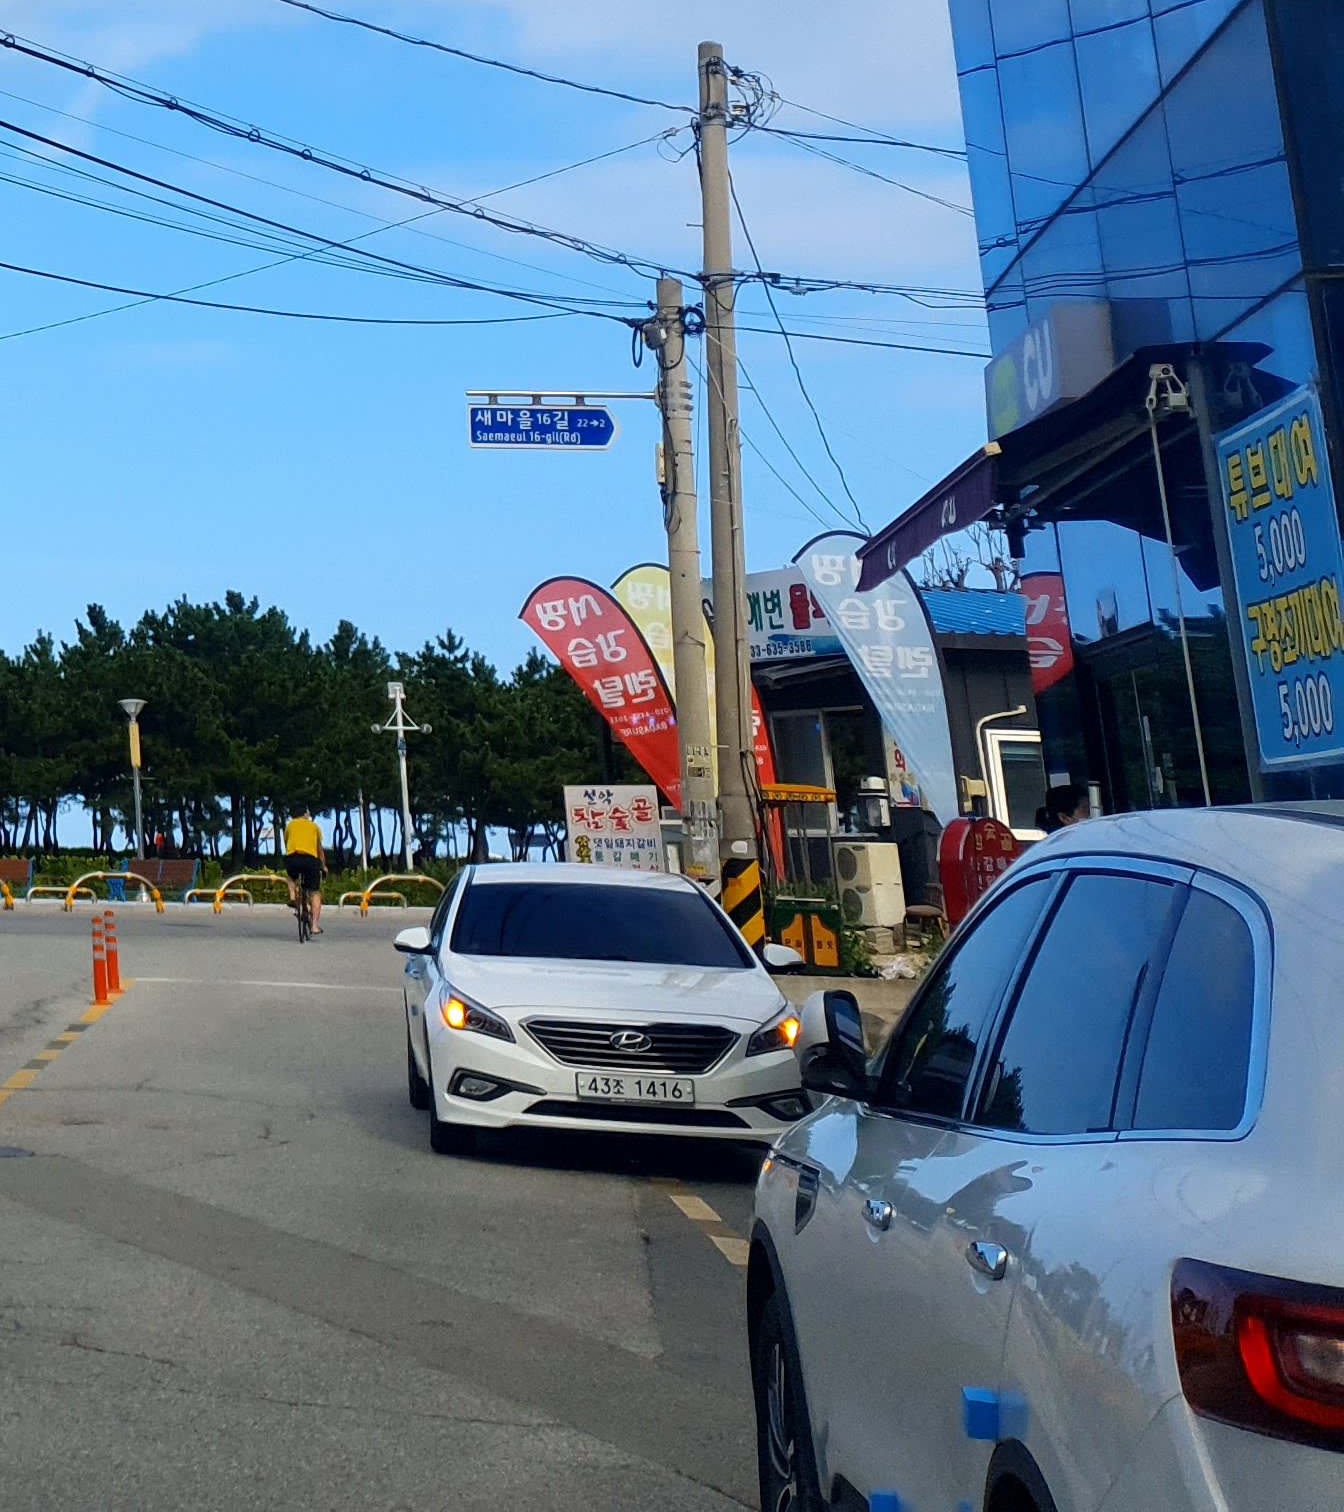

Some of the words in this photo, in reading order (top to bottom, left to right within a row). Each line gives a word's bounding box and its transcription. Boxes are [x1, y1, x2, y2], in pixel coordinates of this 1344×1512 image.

[1023, 319, 1053, 411] CU
[476, 431, 526, 442] Saemaeul
[530, 431, 581, 444] 16-gil(Rd)
[1252, 507, 1306, 586] 5,000
[1278, 673, 1334, 747] 5,000
[587, 1076, 624, 1095] 43조
[634, 1079, 683, 1099] 1416
